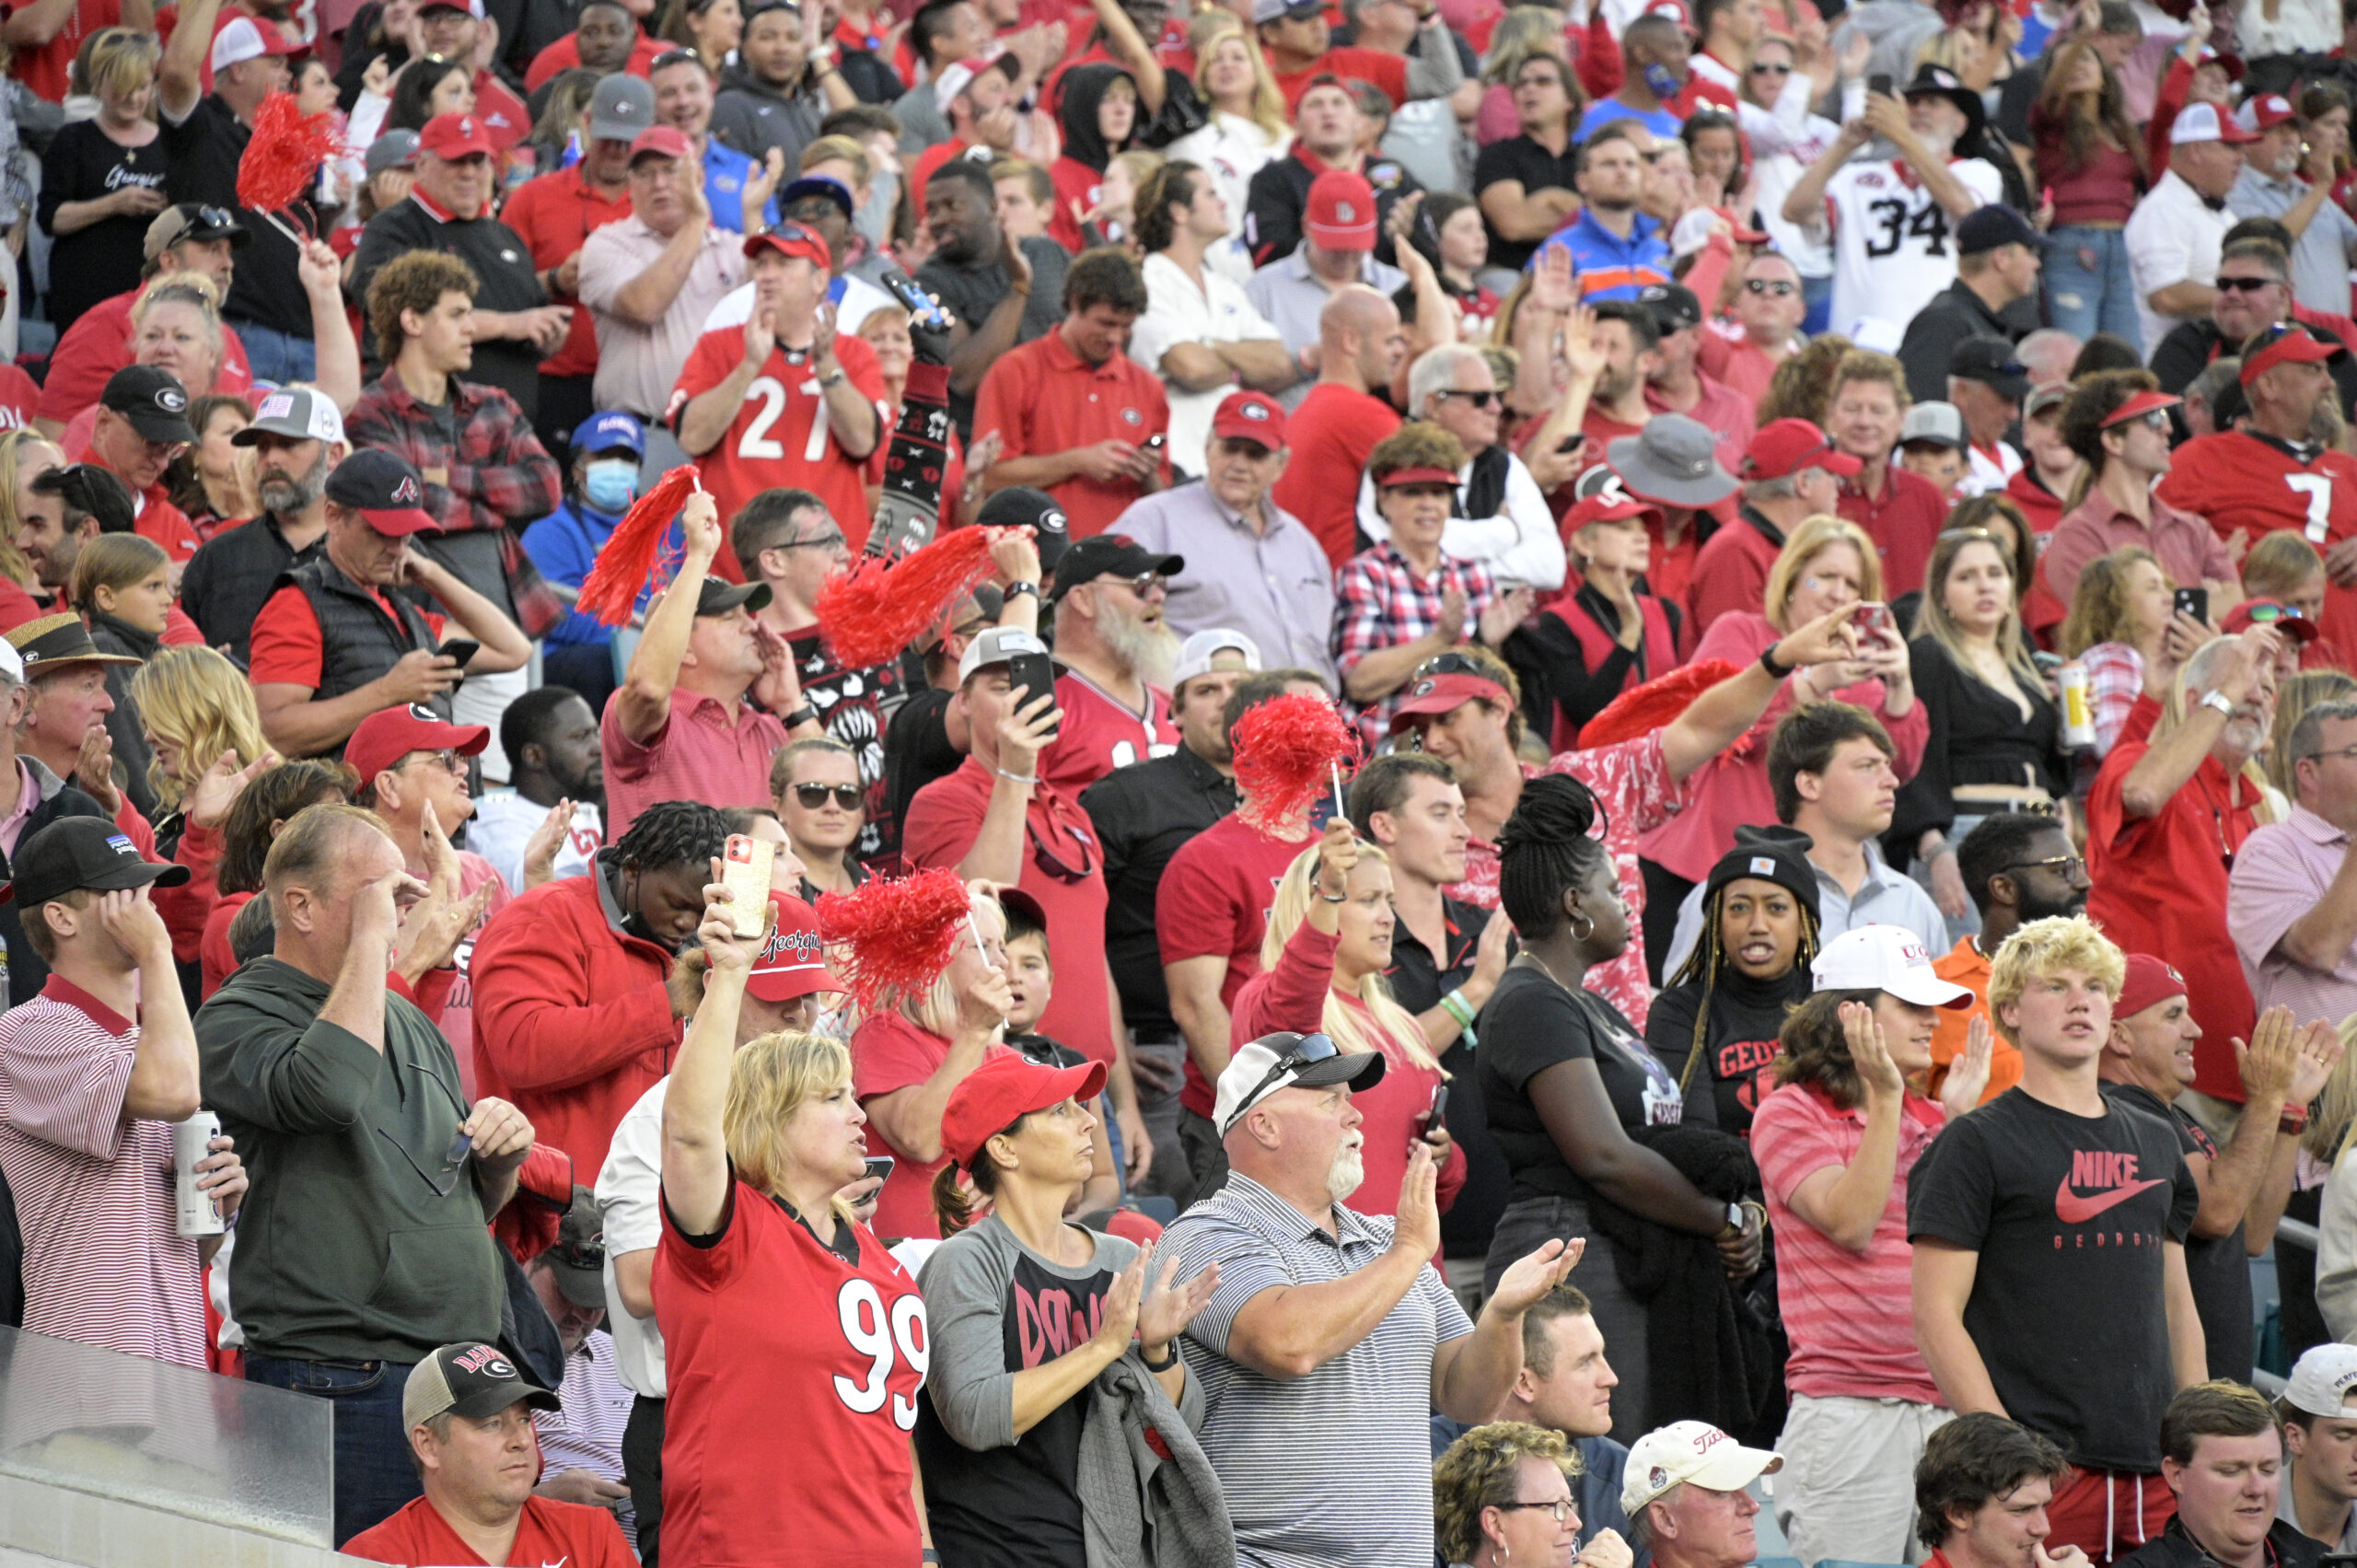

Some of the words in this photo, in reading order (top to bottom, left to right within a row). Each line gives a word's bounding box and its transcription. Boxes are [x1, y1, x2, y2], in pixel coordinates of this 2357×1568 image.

[1865, 199, 1948, 258] 34
[2283, 471, 2332, 544] 7
[2072, 1149, 2141, 1189] NIKE
[832, 1277, 931, 1431] 99
